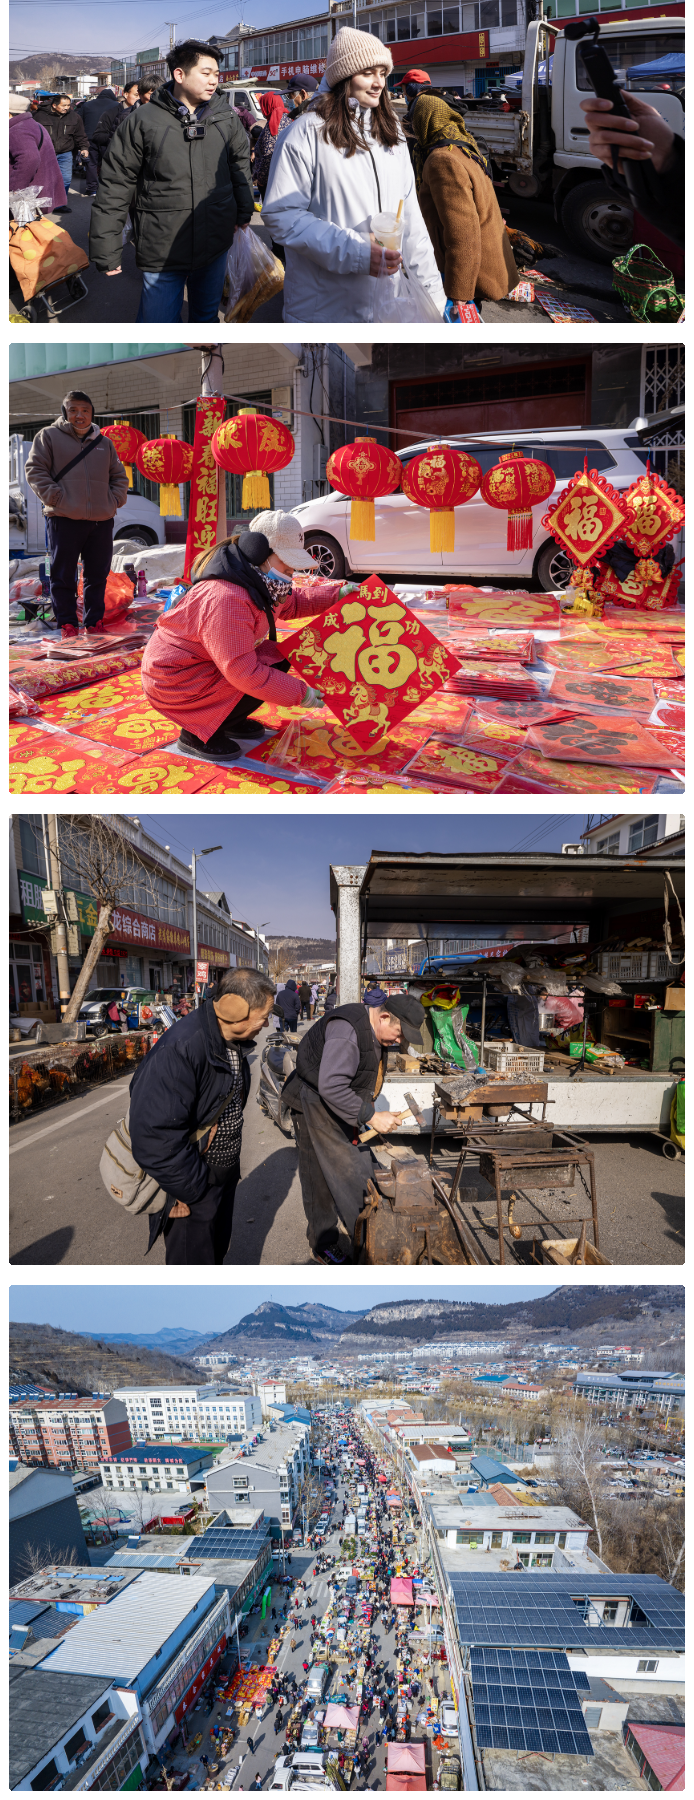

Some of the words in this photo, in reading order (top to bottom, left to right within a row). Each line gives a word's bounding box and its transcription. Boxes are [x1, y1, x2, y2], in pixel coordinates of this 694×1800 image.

[562, 494, 602, 541] 福
[628, 494, 660, 537] 福
[357, 586, 387, 604] 馬到
[322, 612, 340, 630] 成
[404, 620, 420, 635] 功
[323, 601, 418, 689] 福
